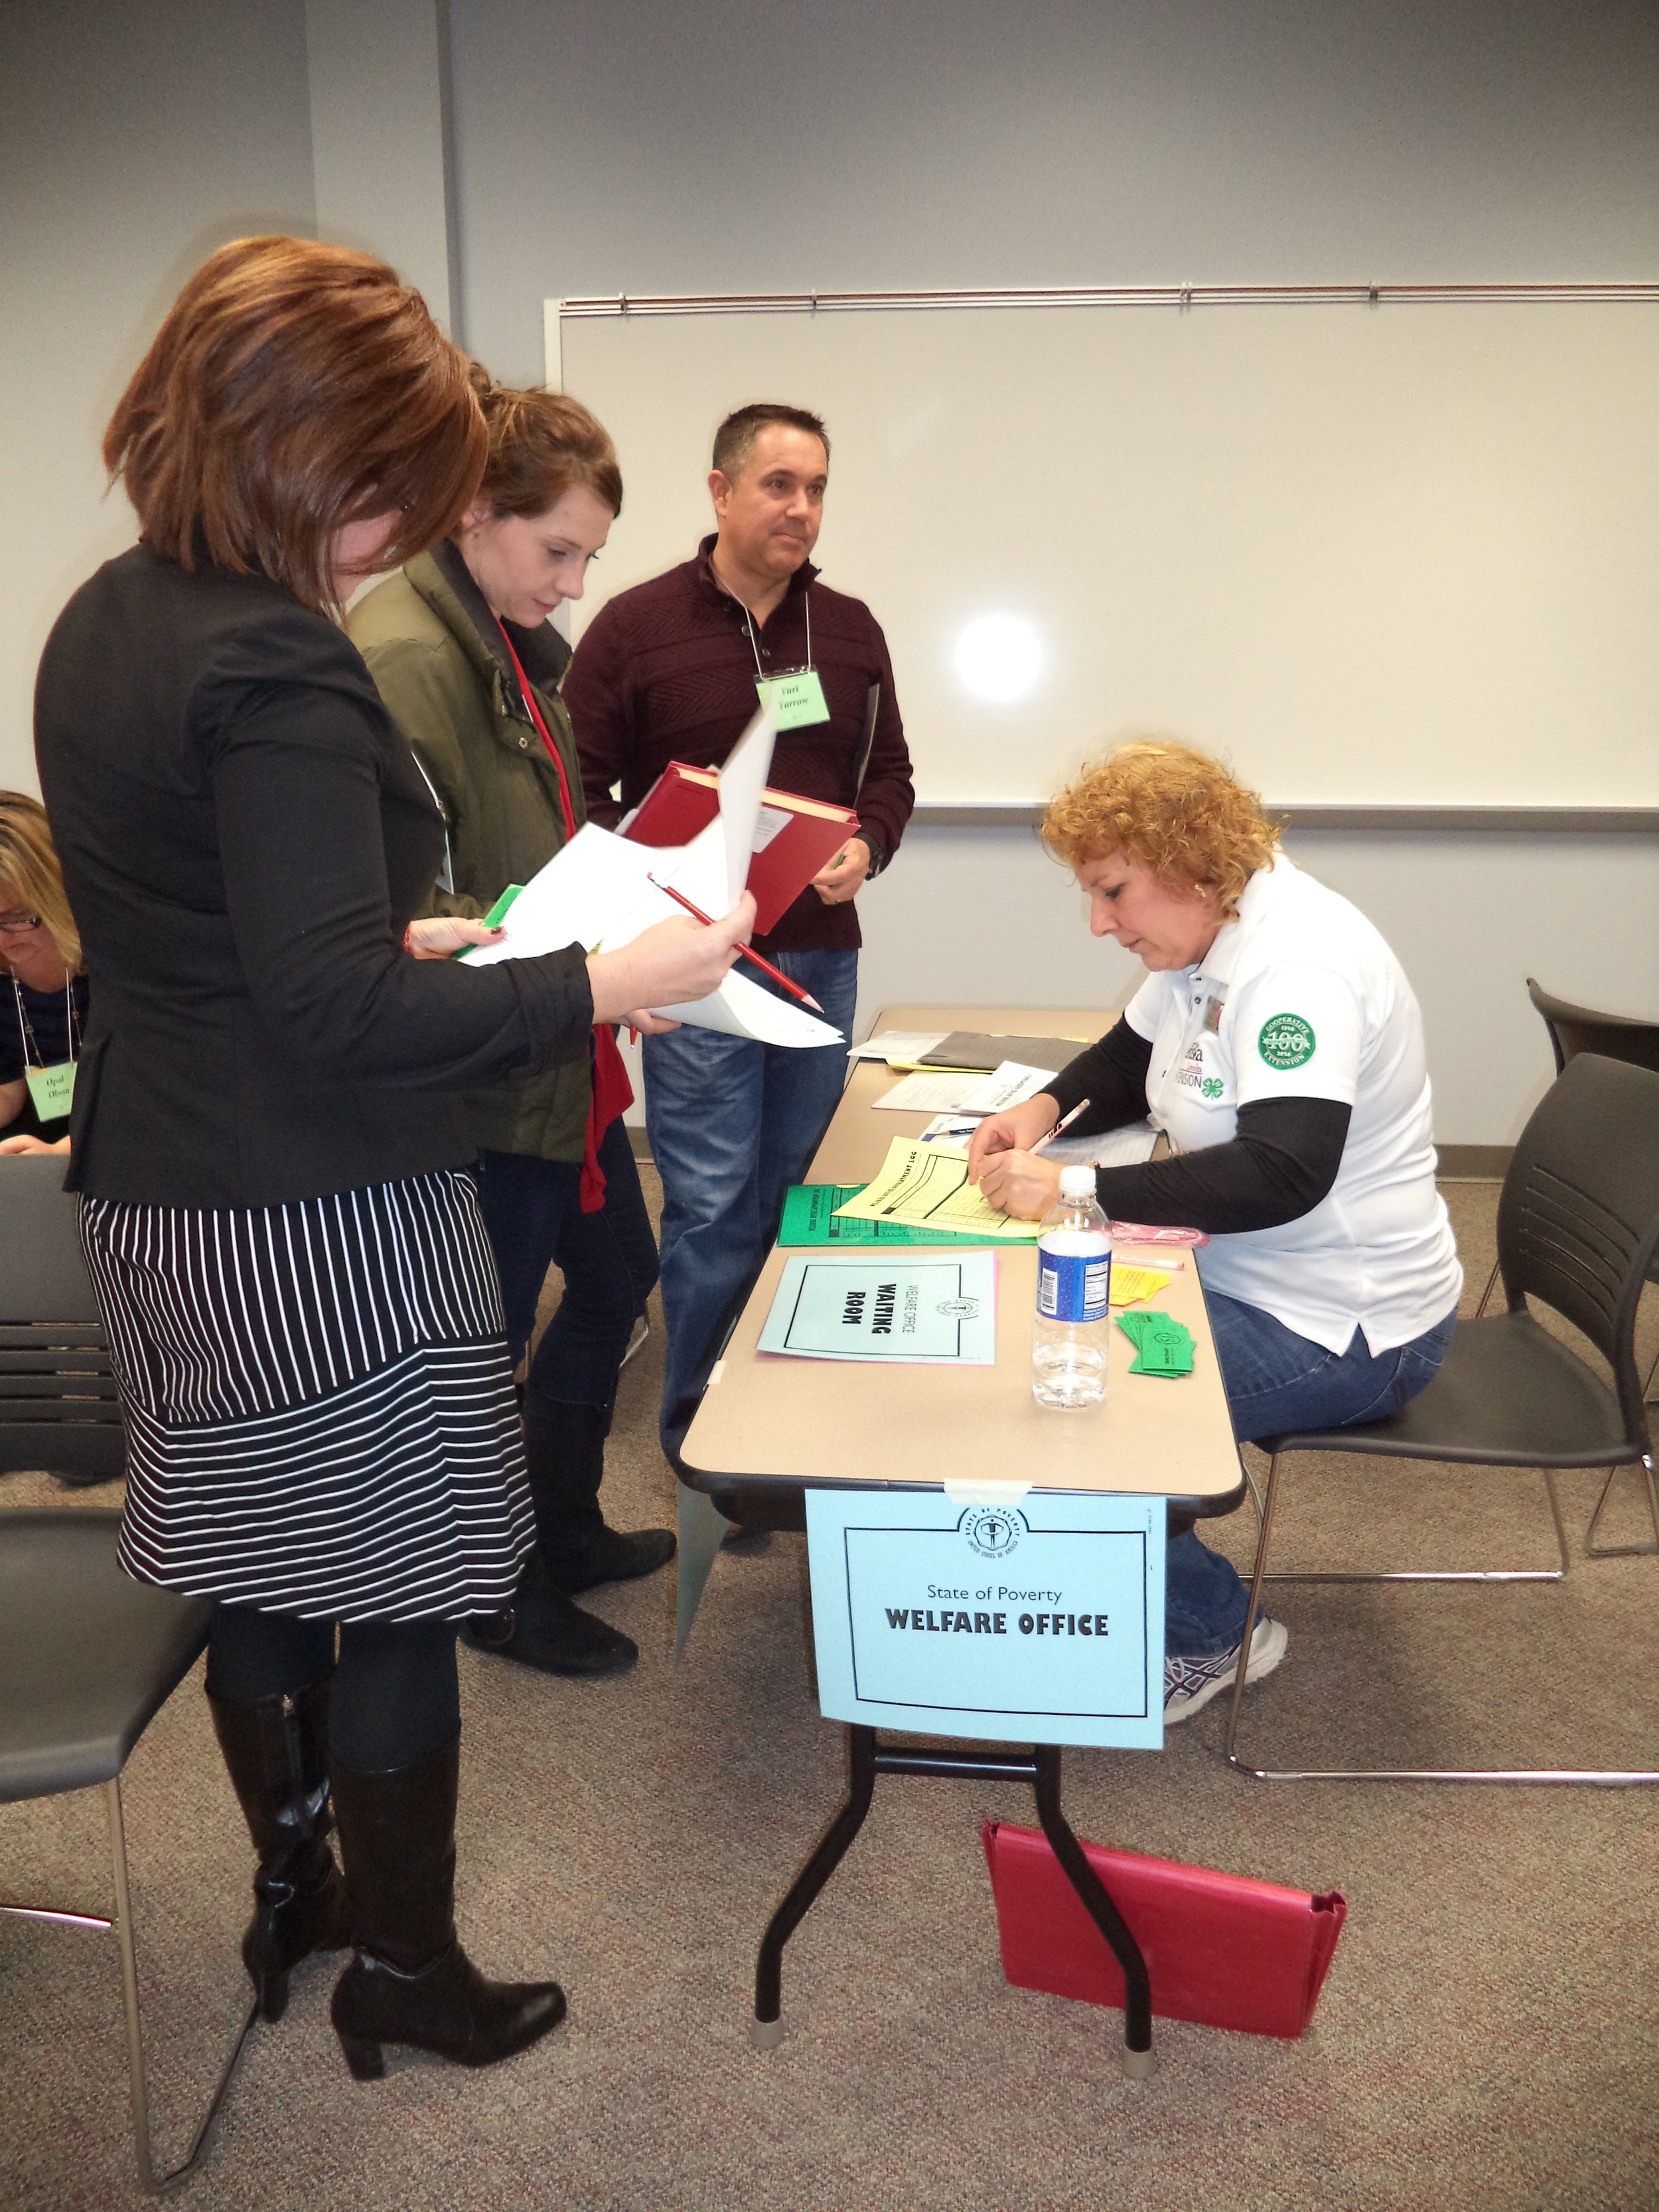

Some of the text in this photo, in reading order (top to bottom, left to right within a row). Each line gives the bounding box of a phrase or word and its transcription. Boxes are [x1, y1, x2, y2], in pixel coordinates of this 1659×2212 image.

[779, 698, 808, 709] Yarrow
[1265, 1017, 1310, 1034] COOPERATIVE
[1267, 1031, 1305, 1052] 100
[1263, 1052, 1305, 1067] EXTENSION
[908, 1151, 918, 1163] LOG
[841, 1291, 867, 1325] ROOM
[871, 1283, 897, 1335] WAITING
[902, 1284, 919, 1333] WELFARE OFFICE
[980, 1550, 996, 1559] STATES
[927, 1584, 1063, 1605] State of Poverty
[884, 1607, 1109, 1637] WELFARE OFFICE
